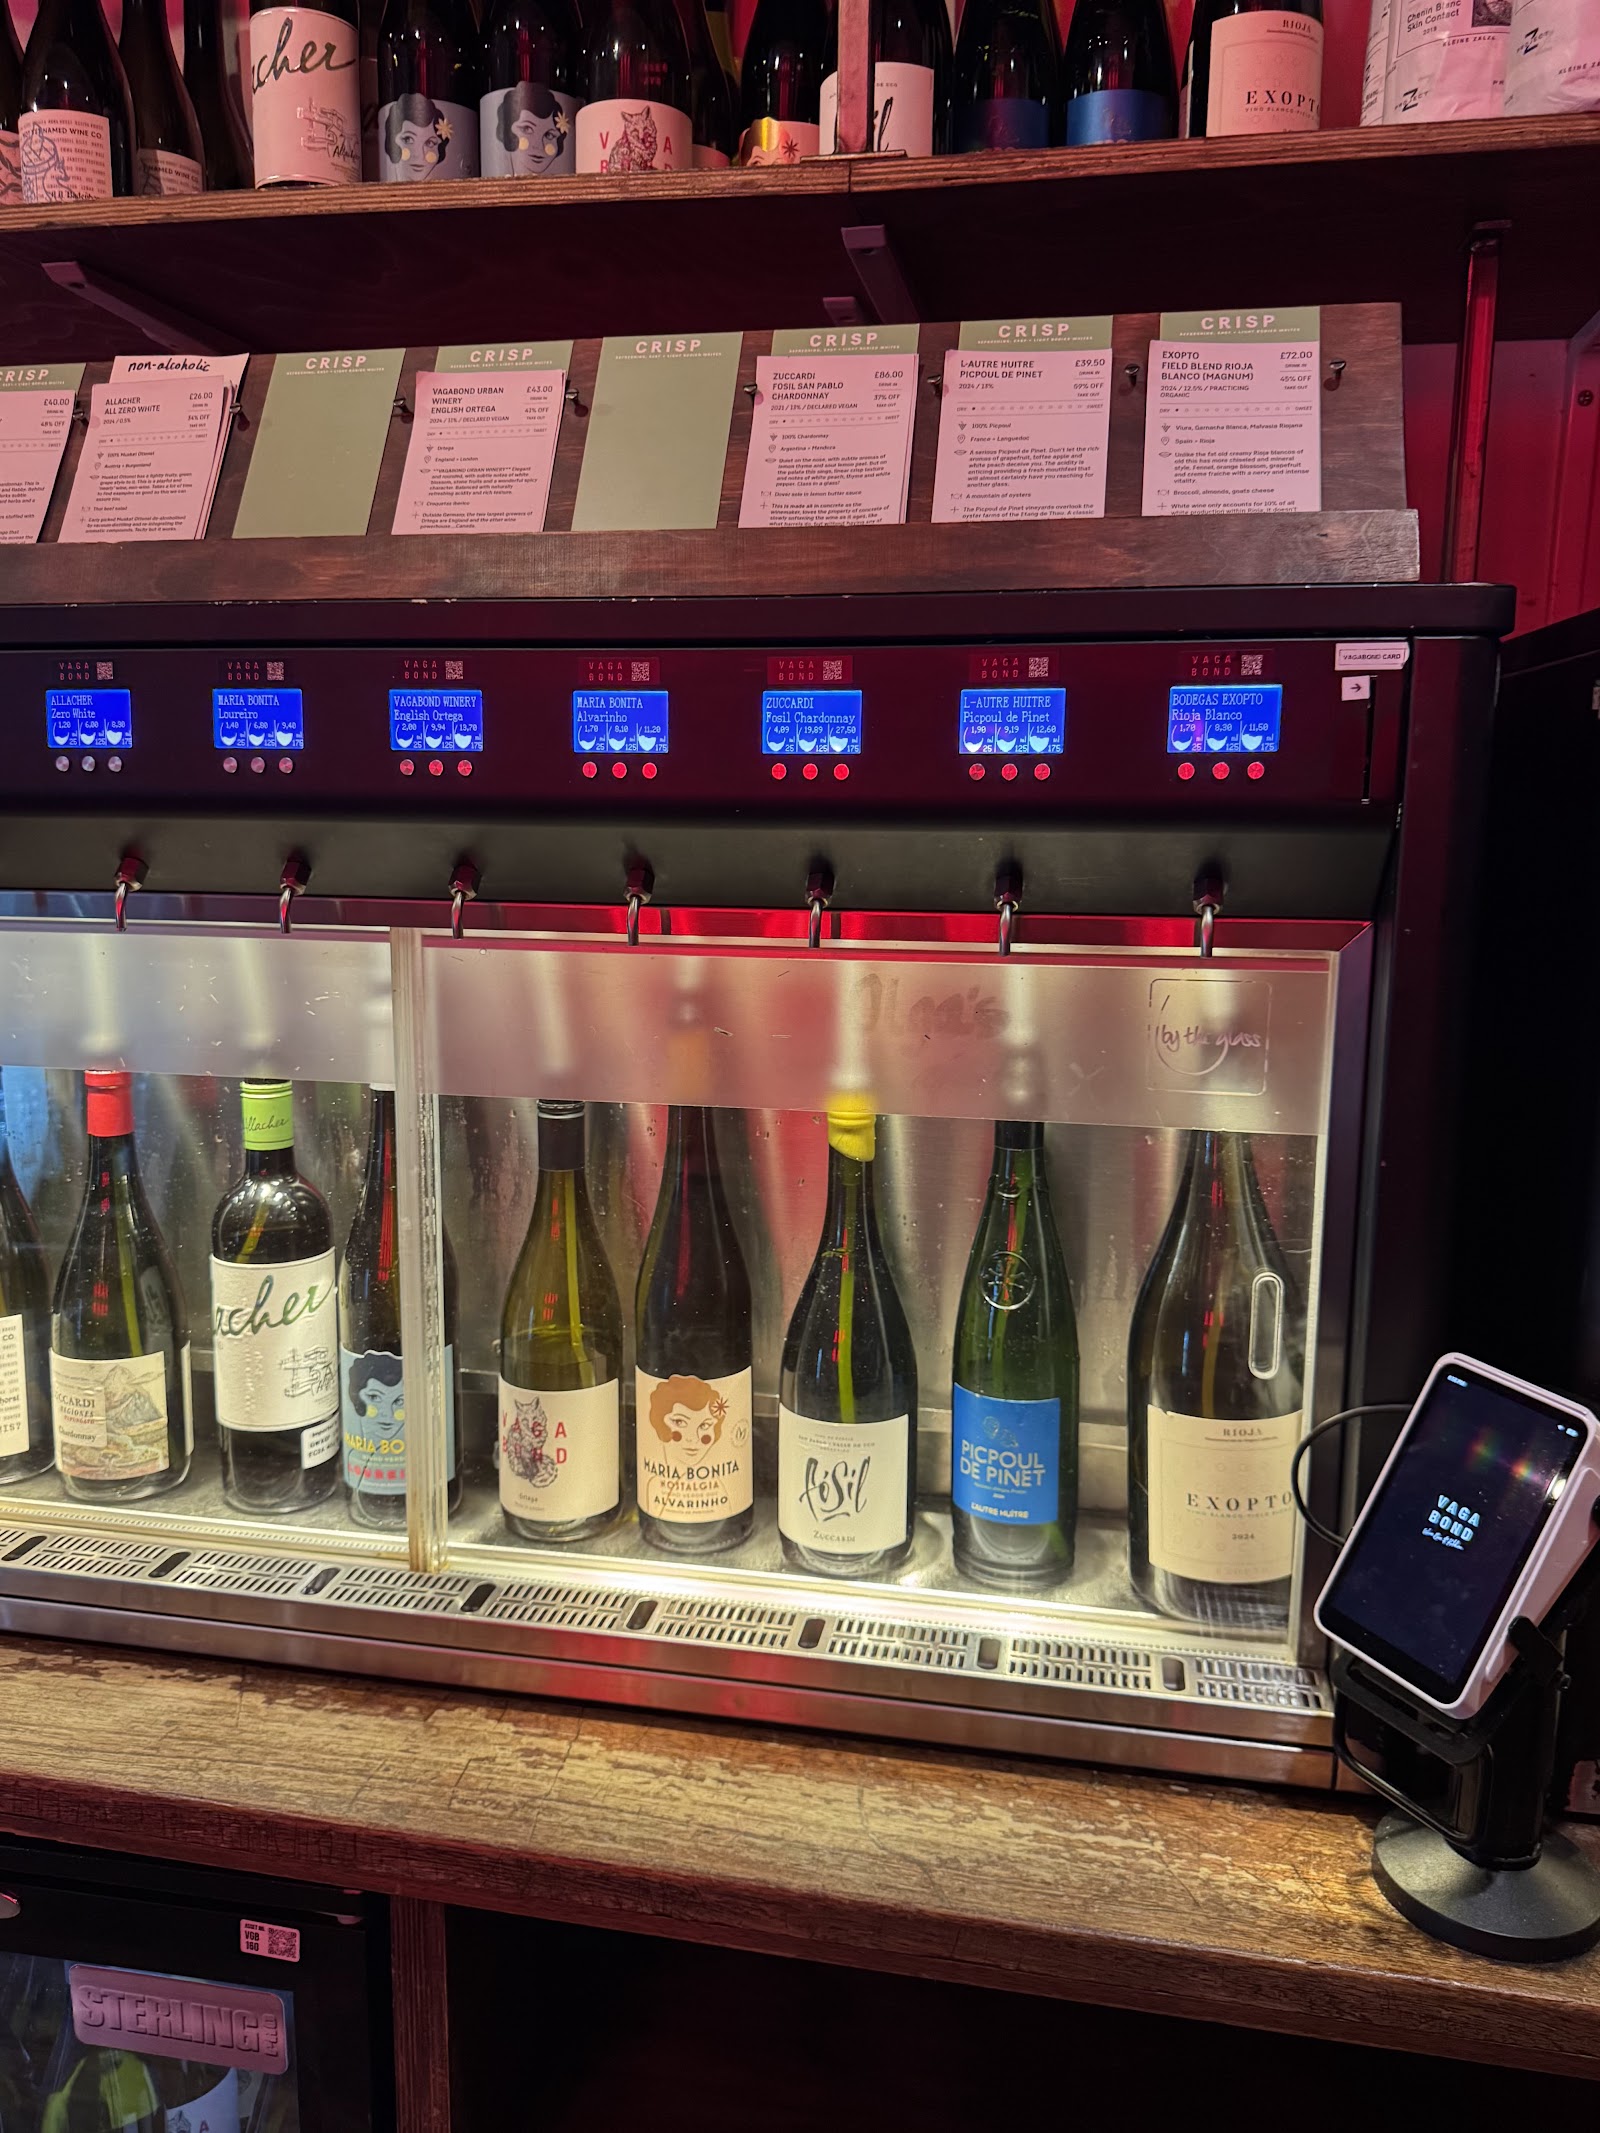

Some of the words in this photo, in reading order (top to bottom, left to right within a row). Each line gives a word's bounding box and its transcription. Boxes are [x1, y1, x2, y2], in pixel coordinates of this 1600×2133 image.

[1407, 7, 1433, 23] Chenin
[1283, 20, 1312, 33] RIOJA
[1407, 20, 1423, 33] Skin
[1425, 9, 1459, 24] Contact
[69, 128, 89, 137] WINE
[1201, 314, 1276, 330] CRISP
[998, 323, 1070, 338] CRISP
[809, 332, 878, 347] CRISP
[635, 339, 702, 354] CRISP
[470, 348, 533, 363] CRISP
[1162, 351, 1200, 360] EXOPTO
[1280, 351, 1313, 360] £72.00
[128, 358, 211, 372] non-alcoholic
[306, 356, 367, 370] CRISP
[960, 360, 998, 368] L-AUTRE
[1001, 360, 1034, 368] HUITRE
[1075, 358, 1106, 367] £39.50
[1161, 362, 1188, 370] FIELD
[1190, 362, 1223, 371] BLEND
[1225, 362, 1254, 370] RIOJA
[773, 372, 815, 380] ZUCCARDI
[874, 371, 903, 379] £86.00
[1016, 370, 1043, 378] PINET
[1161, 372, 1200, 381] BLANCO
[1202, 372, 1254, 381] (MAGNUM)
[432, 387, 475, 395] VAGABOND
[477, 387, 504, 395] URBAN
[526, 386, 553, 394] £43.00
[772, 382, 796, 390] FOSIL
[797, 382, 815, 390] SAN
[817, 382, 844, 390] PABLO
[105, 397, 141, 406] ALLACHER
[189, 392, 213, 400] £26.00
[771, 392, 829, 401] CHARDONNAY
[44, 398, 70, 406] £40.00
[118, 406, 137, 415] ZERO
[138, 405, 160, 413] WHITE
[431, 406, 464, 414] ENGLISH
[465, 405, 496, 413] ORTEGA
[404, 660, 437, 668] VAGA
[779, 661, 814, 669] VAGA
[982, 658, 1018, 666] VAGA
[1192, 656, 1231, 664] VAGA
[589, 662, 622, 670] VAGA
[589, 673, 622, 681] BOND
[982, 670, 1018, 678] BOND
[1191, 668, 1231, 676] BOND
[51, 695, 93, 706] ALLACHER
[218, 695, 245, 706] MARIA
[248, 695, 280, 706] BONITA
[394, 696, 440, 707] VAGABOND
[443, 696, 476, 708] WINERY
[577, 697, 606, 708] MARIA
[609, 697, 643, 709] BONITA
[766, 697, 814, 709] ZUCCARDI
[964, 697, 1009, 708] L-AUTRE
[1013, 696, 1051, 708] HUITRE
[1172, 694, 1218, 706] BODEGAS
[1222, 693, 1263, 705] EXOPTO
[51, 708, 70, 718] Zero
[72, 708, 95, 718] White
[218, 708, 258, 719] Loureiro
[394, 710, 430, 722] English
[433, 710, 463, 722] Ortega
[577, 711, 628, 723] Alvarinho
[766, 712, 791, 723] Fosil
[794, 712, 855, 724] Chardonnay
[963, 711, 1002, 724] Picpoul
[1006, 711, 1018, 722] de
[1021, 711, 1049, 723] Pinet
[1172, 709, 1201, 722] Rioja
[1205, 709, 1242, 720] Blanco
[1161, 1024, 1180, 1052] by
[1223, 1428, 1263, 1437] RIOJA
[961, 1439, 1044, 1469] PICPOUL
[644, 1456, 681, 1479] MARIA
[687, 1460, 739, 1480] BONITA
[960, 1456, 980, 1480] DE
[986, 1466, 1045, 1487] PINET
[660, 1480, 719, 1491] NOSTALGIA
[654, 1495, 728, 1508] ALVARINHO
[1187, 1490, 1292, 1512] EXOPTO
[1437, 1494, 1481, 1528] VAGA
[1428, 1509, 1474, 1542] BOND
[245, 1931, 260, 1941] VGB
[246, 1940, 259, 1951] 160
[77, 1985, 260, 2053] STERLING
